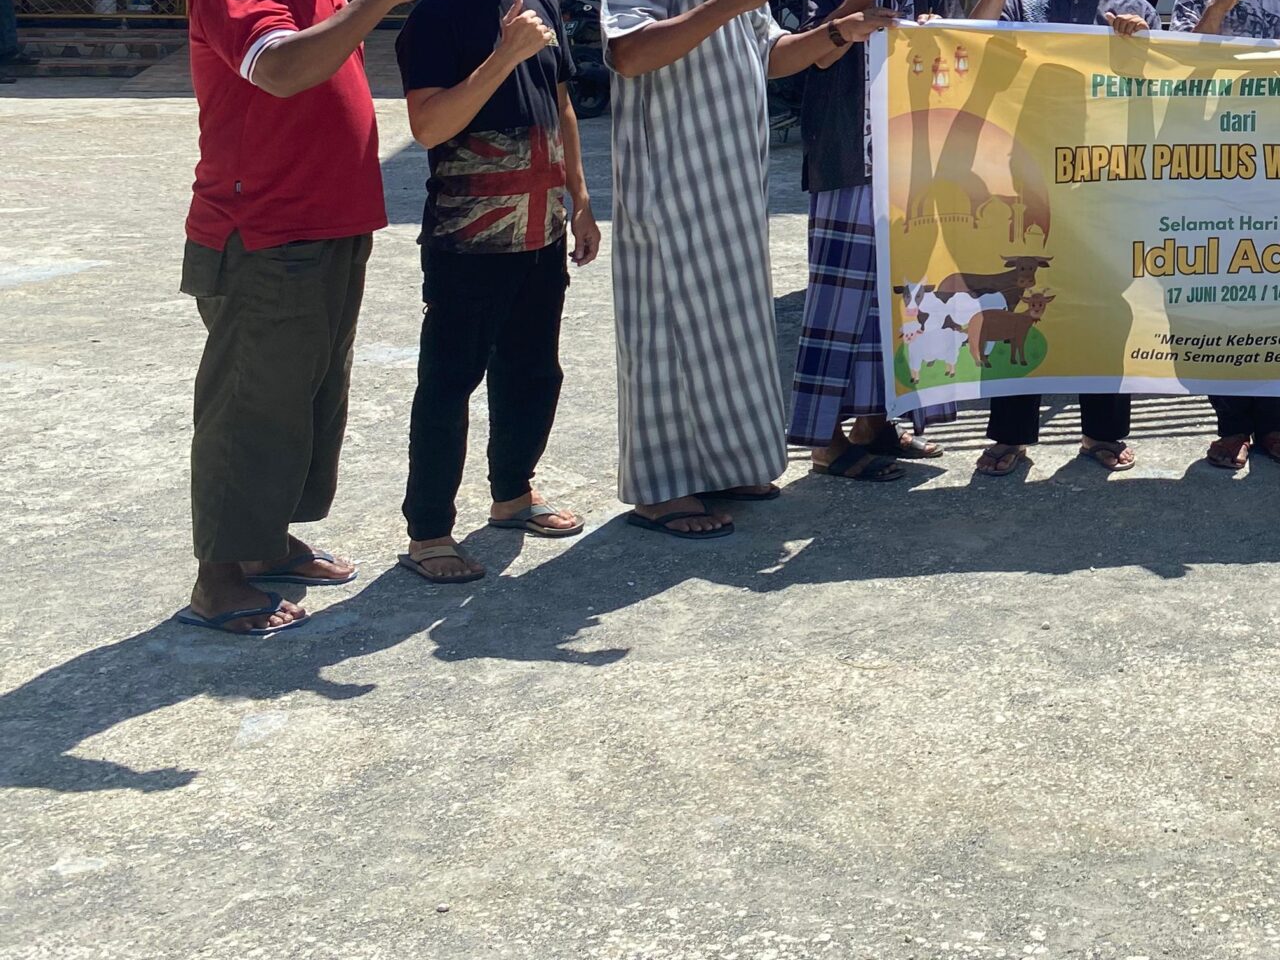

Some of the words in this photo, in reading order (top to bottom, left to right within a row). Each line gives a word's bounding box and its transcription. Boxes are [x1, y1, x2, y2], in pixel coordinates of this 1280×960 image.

[1091, 73, 1233, 97] PENYERAHAN
[1219, 110, 1257, 133] dari
[1055, 143, 1147, 185] BAPAK
[1152, 143, 1257, 181] PAULUS
[1158, 216, 1235, 233] Selamat
[1239, 215, 1279, 231] Hari
[1132, 236, 1220, 279] Idul
[1167, 287, 1183, 304] 17
[1186, 286, 1217, 303] JUNI
[1221, 284, 1257, 302] 2024
[1153, 332, 1223, 351] "Merajut
[1130, 347, 1179, 362] dalam
[1183, 350, 1261, 367] Semangat
